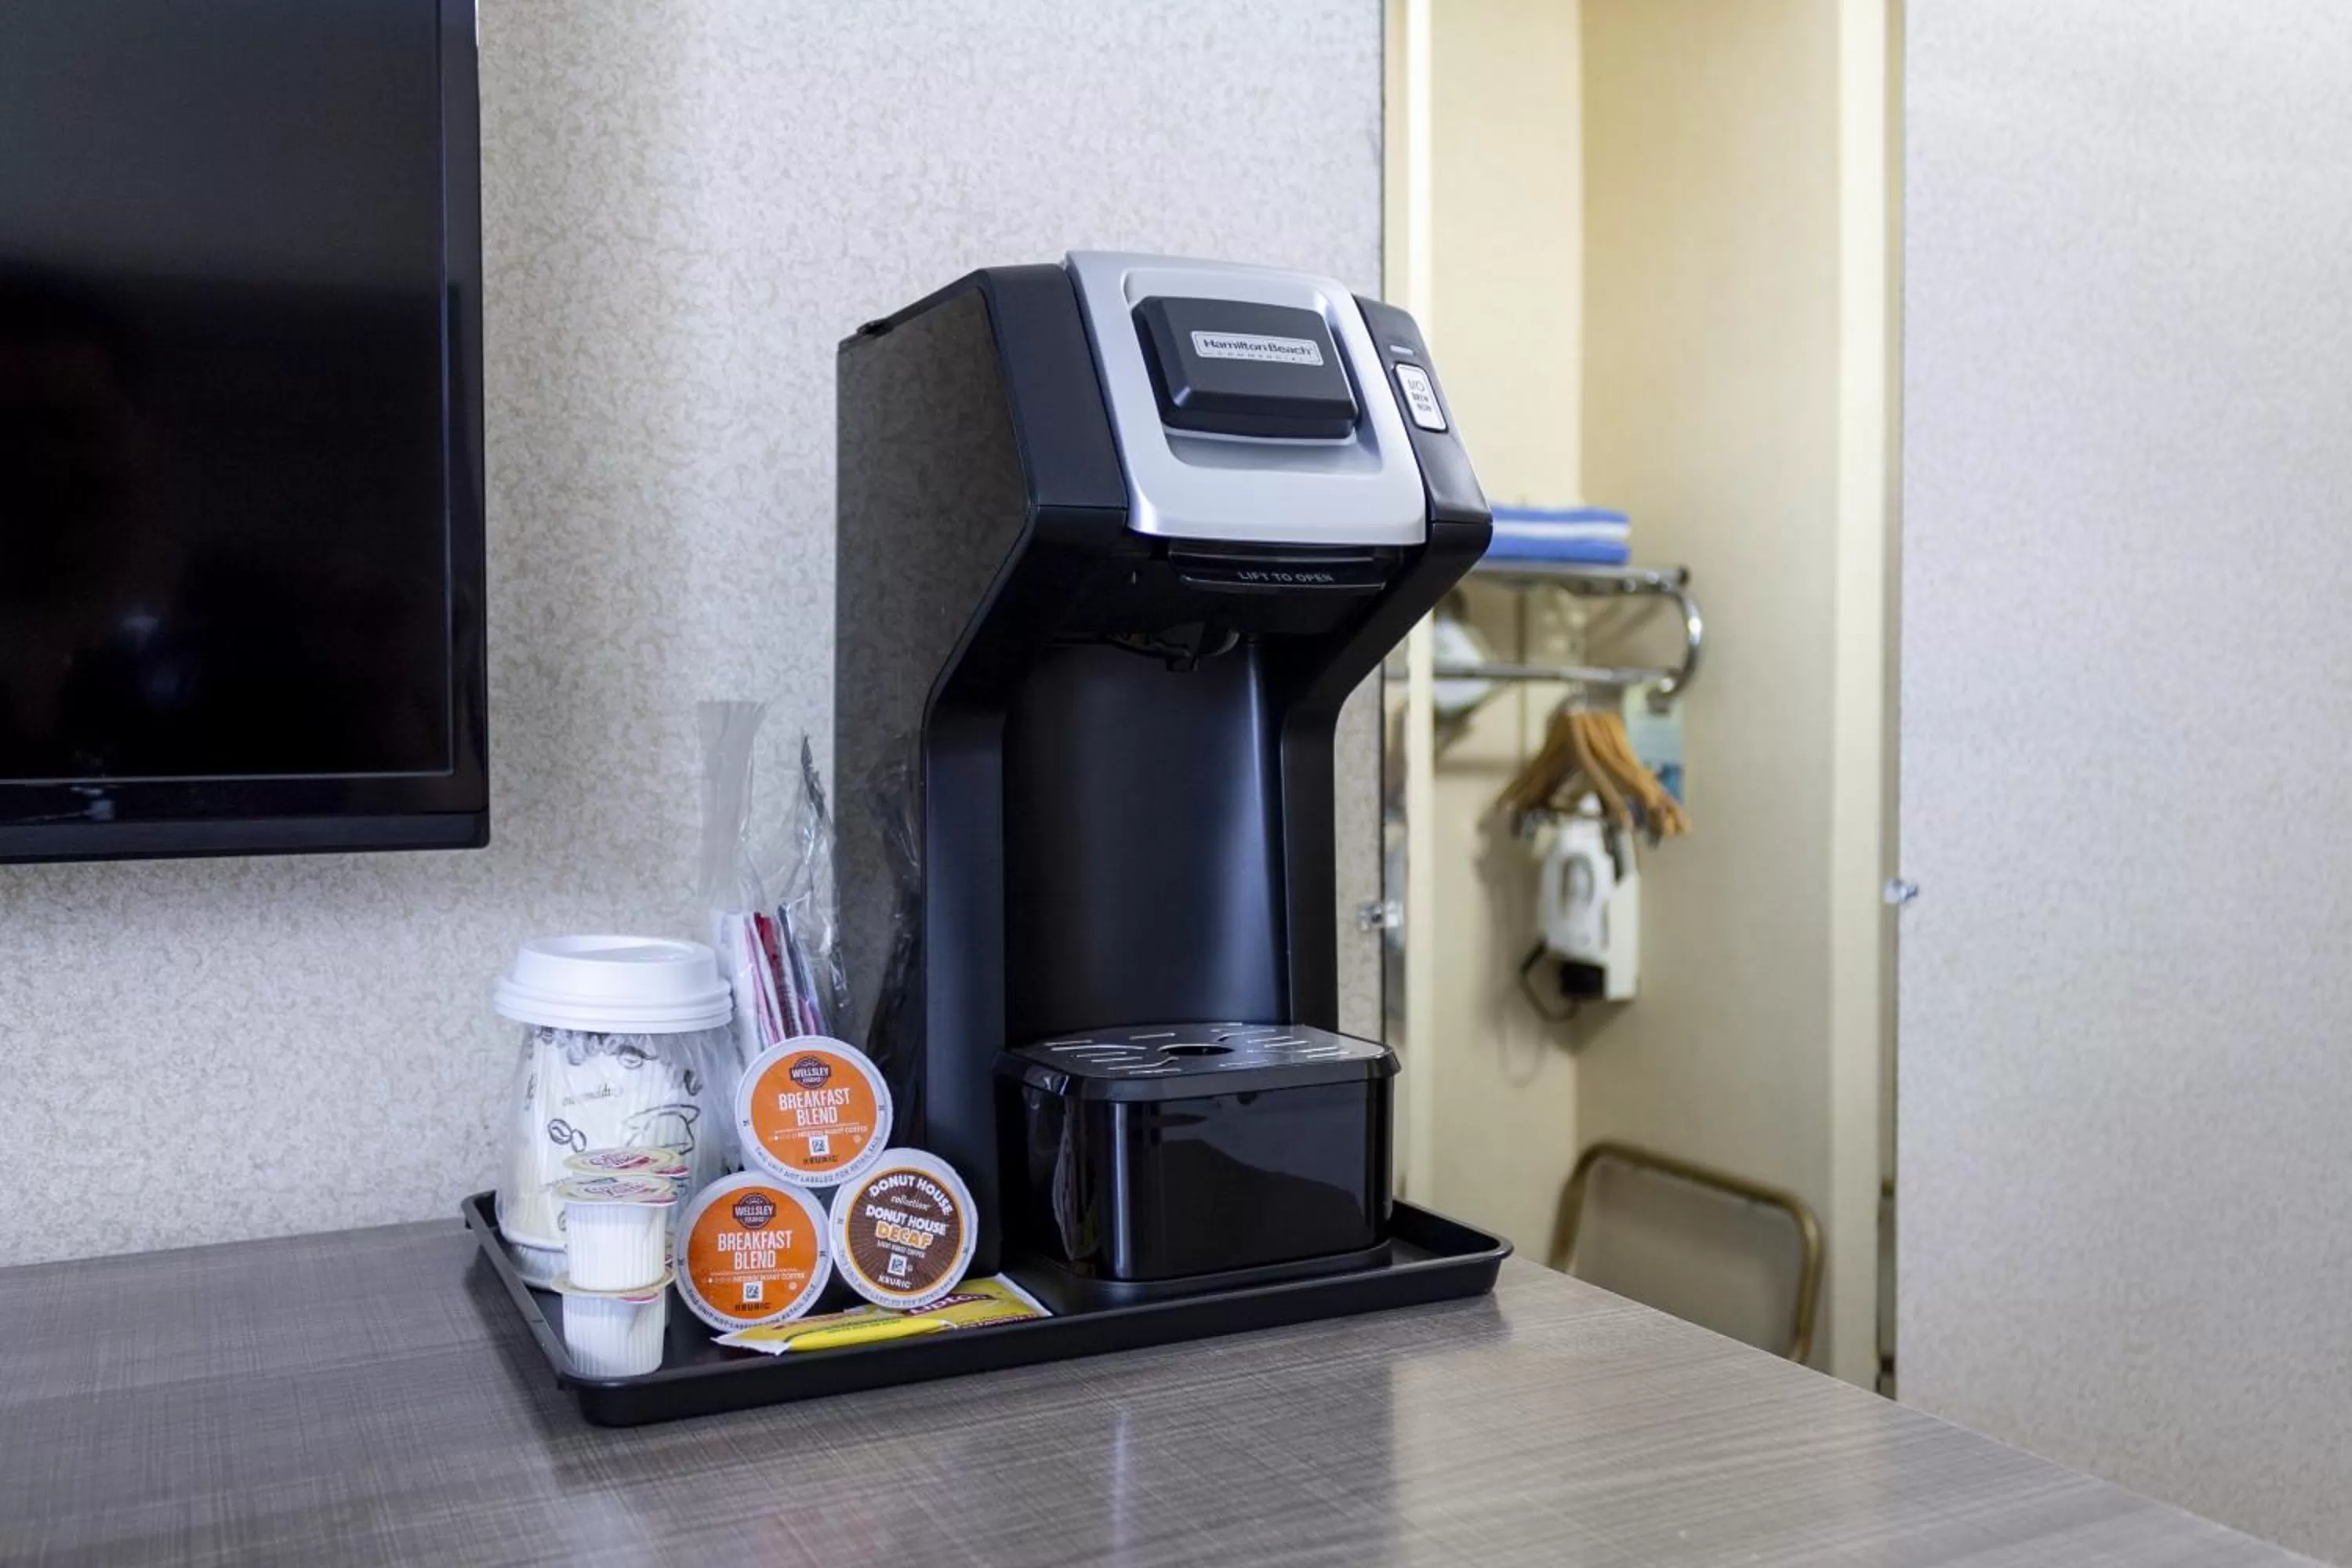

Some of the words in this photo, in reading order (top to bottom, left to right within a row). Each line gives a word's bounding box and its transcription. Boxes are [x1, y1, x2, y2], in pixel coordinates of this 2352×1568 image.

[1238, 571, 1269, 581] LIFT
[1294, 573, 1334, 582] OPEN
[791, 1067, 829, 1079] WELLSLEY
[779, 1087, 851, 1111] BREAKFAST
[796, 1106, 837, 1127] BLEND
[869, 1174, 916, 1196] DONUT
[916, 1178, 953, 1216] HOUSE
[735, 1205, 773, 1216] WELLSLEY
[866, 1204, 907, 1225] DONUT
[907, 1215, 947, 1236] HOUSE
[717, 1230, 793, 1251] BREAKFAST
[876, 1221, 934, 1250] DECAF
[735, 1250, 776, 1270] BLEND
